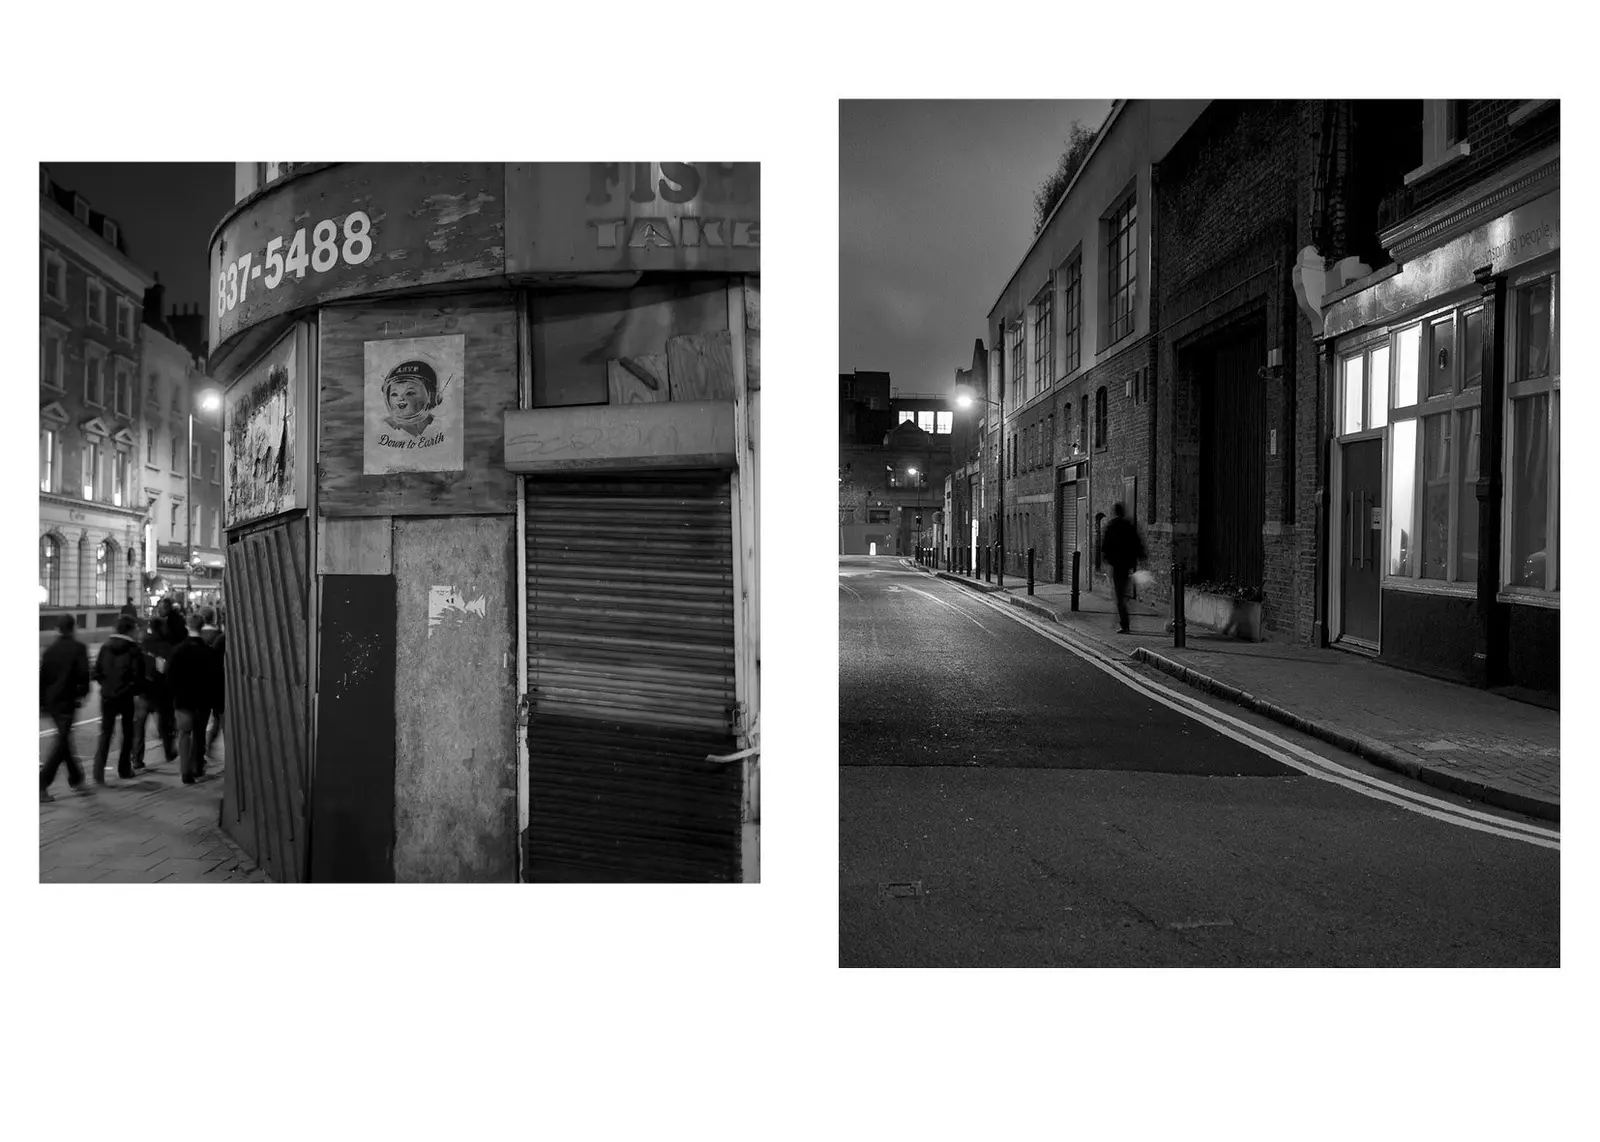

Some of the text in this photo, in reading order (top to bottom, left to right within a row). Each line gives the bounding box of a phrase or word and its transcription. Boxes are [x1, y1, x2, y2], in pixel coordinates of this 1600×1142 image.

[217, 210, 373, 318] 837-5488
[378, 432, 445, 449] Down to Earth
